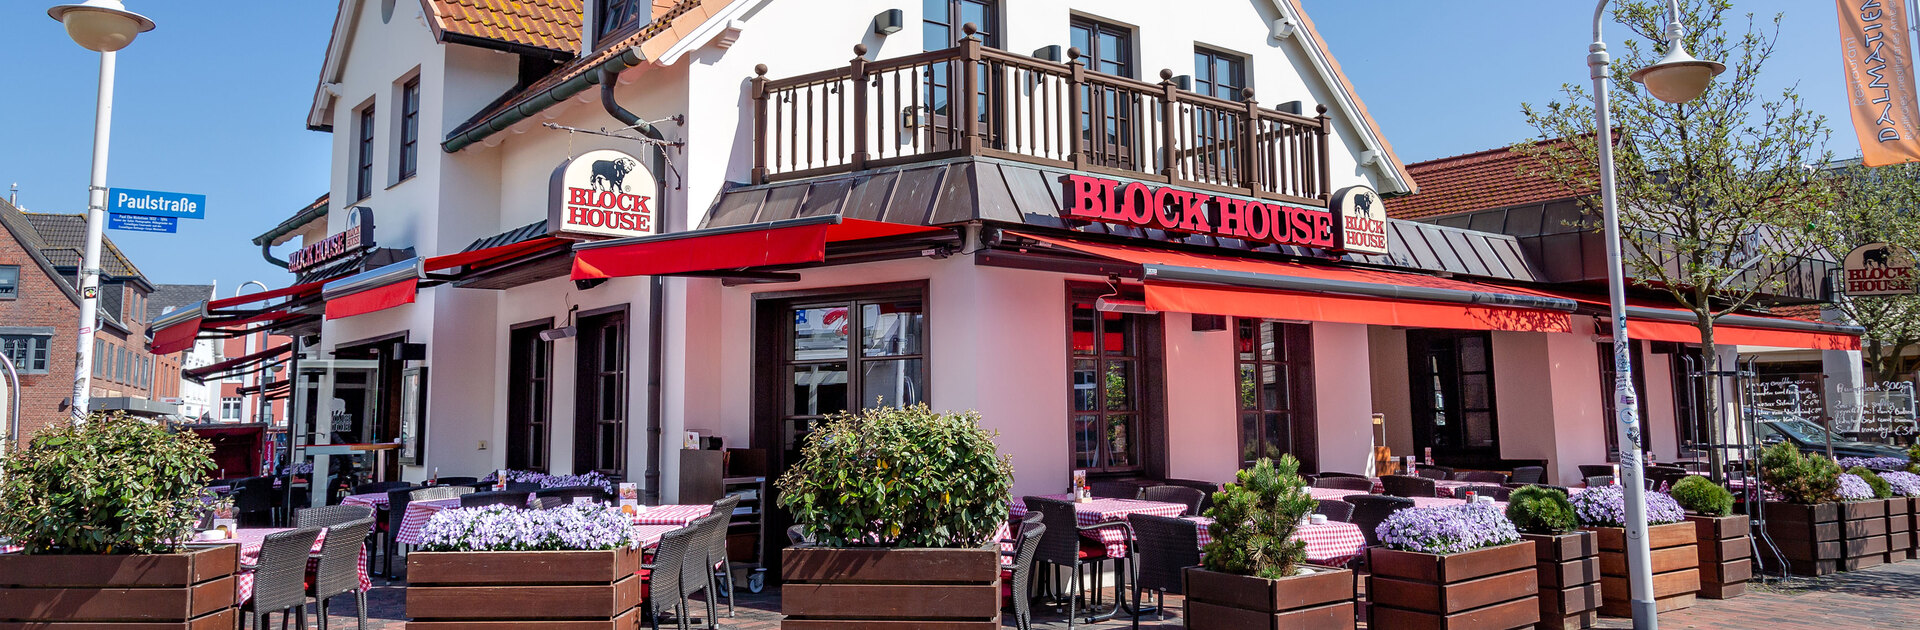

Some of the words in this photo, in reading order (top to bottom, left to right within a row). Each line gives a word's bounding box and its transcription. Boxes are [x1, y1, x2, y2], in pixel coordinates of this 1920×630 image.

[1887, 0, 1899, 31] Ambie
[1844, 37, 1865, 107] Restaurant
[118, 192, 197, 213] Paulstraße
[568, 187, 651, 214] BLOCK
[1069, 174, 1212, 233] BLOCK
[1216, 196, 1334, 248] HOUSE
[567, 206, 651, 232] HOUSE
[1344, 215, 1385, 235] BLOCK
[288, 244, 314, 273] BLOCK
[314, 232, 345, 263] HOUSE
[1345, 230, 1386, 249] HOUSE
[1847, 267, 1912, 281] BLOCK
